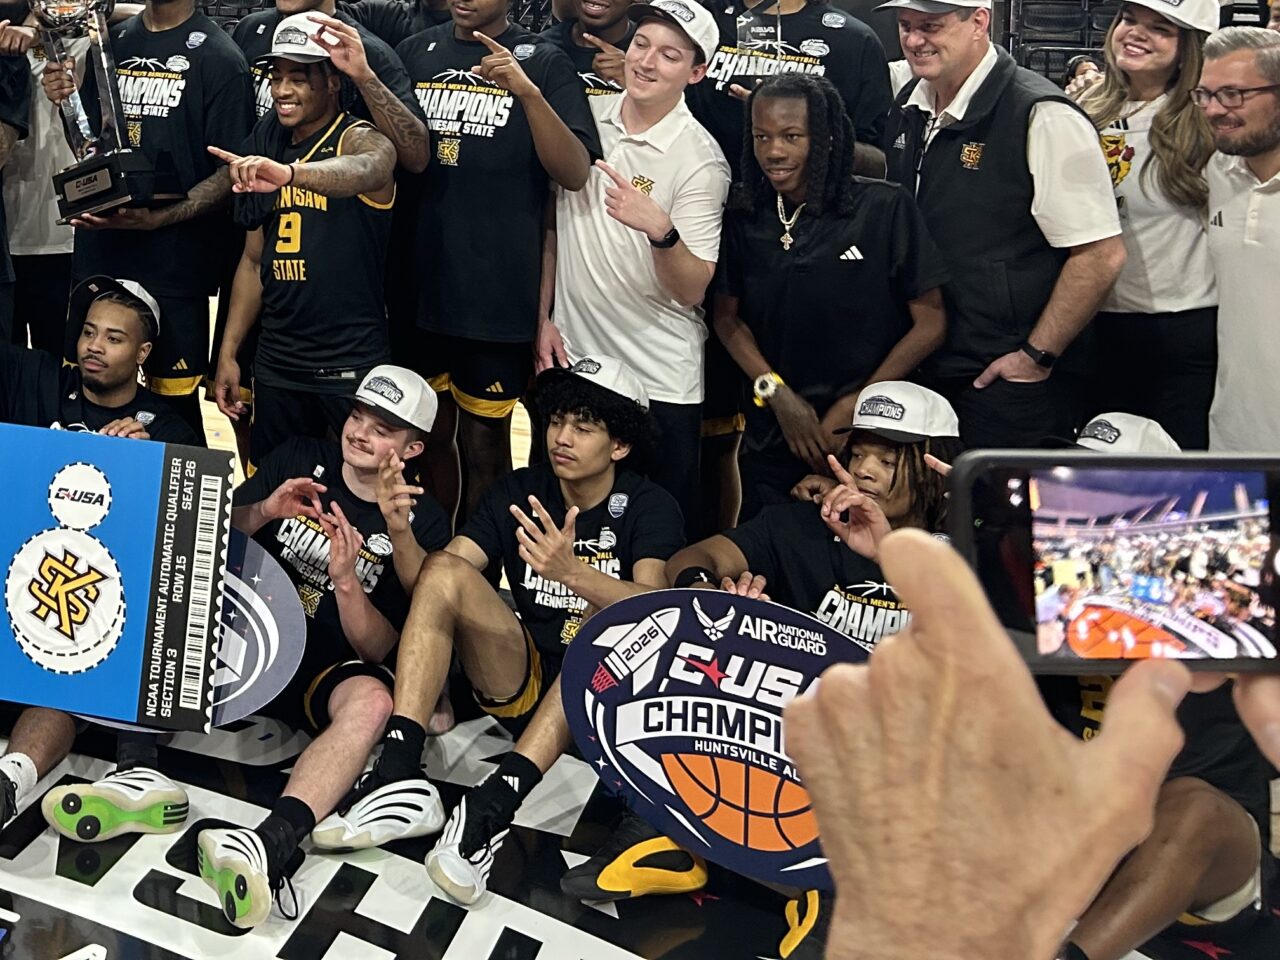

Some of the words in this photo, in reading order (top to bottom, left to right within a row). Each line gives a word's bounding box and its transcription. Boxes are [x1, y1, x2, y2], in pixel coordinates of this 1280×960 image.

[117, 75, 187, 108] AMPIONS
[467, 85, 510, 97] BASKETBALL
[142, 106, 170, 118] STATE
[462, 122, 497, 138] STATE
[275, 211, 302, 254] 9
[272, 259, 307, 281] STATE
[365, 377, 402, 405] CHAMPIONS
[860, 400, 906, 421] CHAMPIONS
[185, 460, 197, 478] 26
[166, 457, 182, 522] QUALIFIER
[182, 479, 194, 511] SEAT
[158, 524, 176, 596] AUTOMATIC
[175, 555, 187, 572] 15
[171, 573, 185, 603] ROW
[847, 593, 868, 607] CUSA
[870, 598, 898, 612] MEN'S
[149, 596, 167, 680] TOURNAMENT
[621, 626, 660, 662] 2026
[738, 615, 779, 645] AIR
[778, 624, 828, 645] NATIONAL
[167, 648, 178, 658] 3
[776, 639, 828, 657] GUARD
[146, 683, 159, 718] NCAA
[160, 660, 177, 718] SECTION
[643, 700, 784, 761] CHAMPI
[694, 741, 779, 772] HUNTSVILLE
[783, 766, 803, 784] AL
